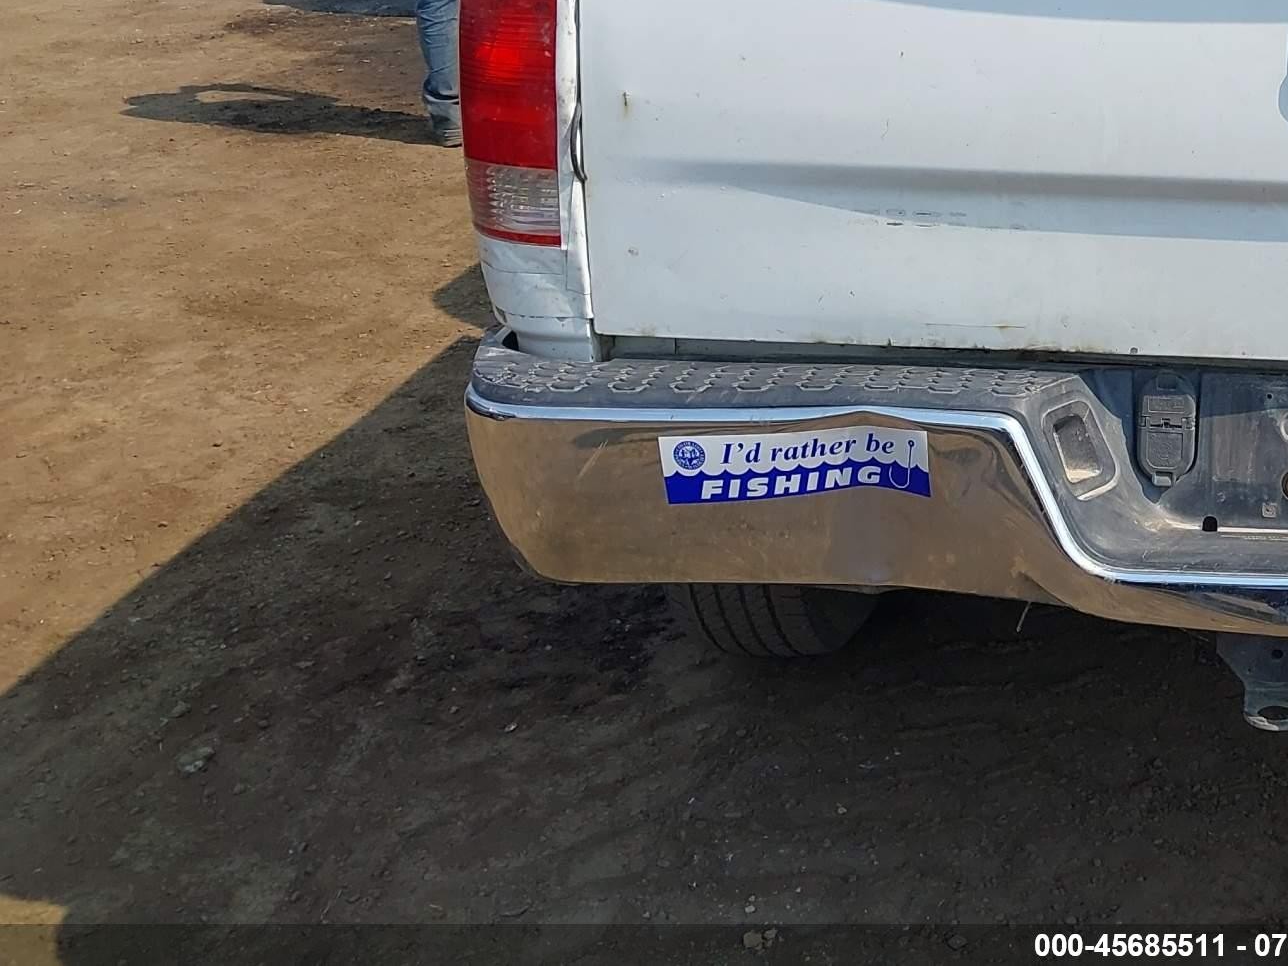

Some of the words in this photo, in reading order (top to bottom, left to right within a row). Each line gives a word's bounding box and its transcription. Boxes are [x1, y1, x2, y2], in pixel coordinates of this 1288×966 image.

[720, 442, 761, 465] I'd
[771, 438, 856, 462] rather
[865, 433, 895, 454] be
[701, 465, 881, 500] FISHING
